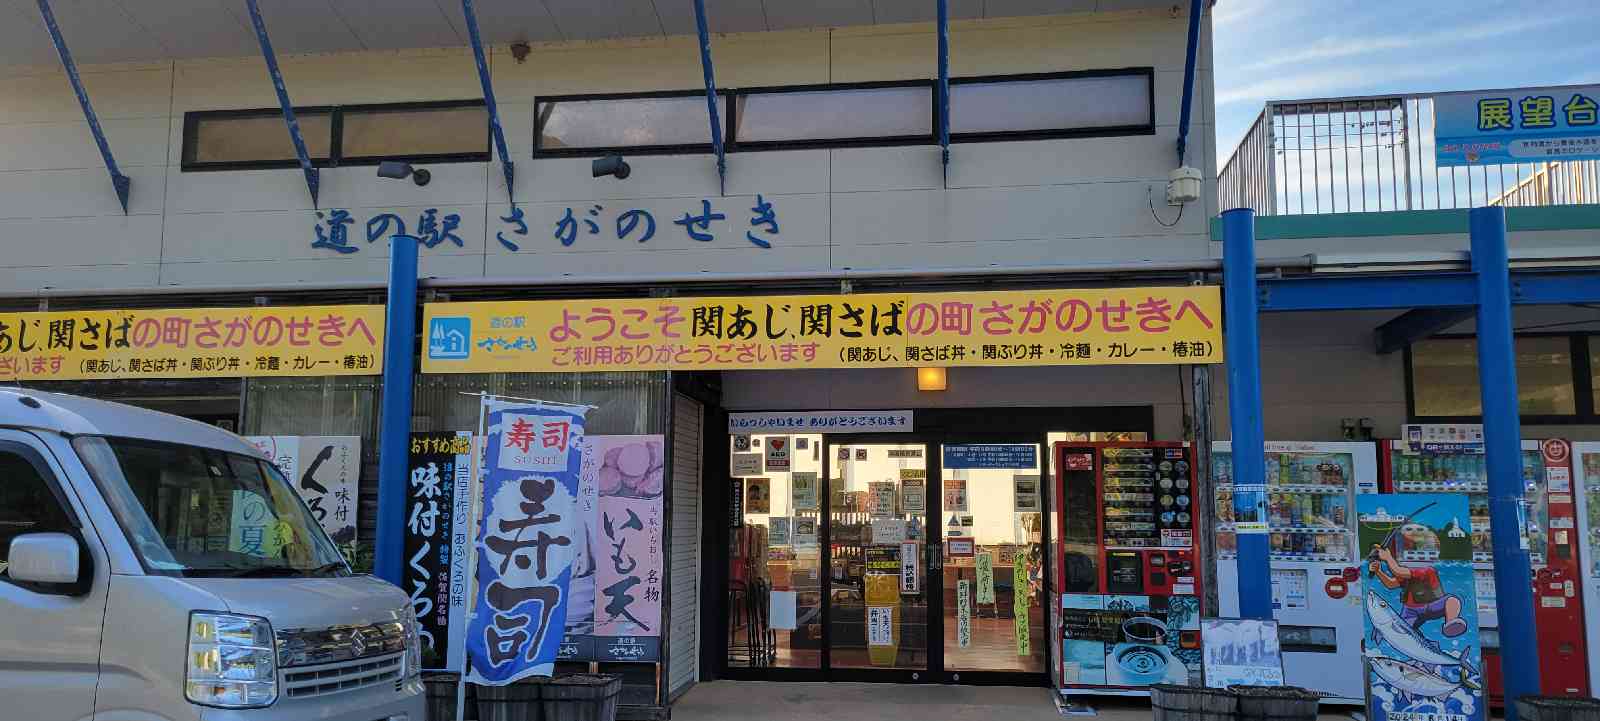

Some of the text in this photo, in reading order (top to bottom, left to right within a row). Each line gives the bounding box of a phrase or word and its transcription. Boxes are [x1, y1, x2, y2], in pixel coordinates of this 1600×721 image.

[1478, 94, 1599, 131] 展望台
[311, 195, 779, 253] 道の駅 さがのせき
[552, 341, 820, 367] ご利用ありがとうございます
[504, 417, 570, 455] 寿司
[730, 415, 906, 427] いらっしゃいませ ありがとうございます
[301, 445, 335, 528] くろ
[334, 487, 351, 522] 味付
[451, 535, 466, 608] おふくろの味
[485, 479, 571, 666] 寿司
[602, 508, 651, 632] いも天
[644, 569, 660, 602] 名物
